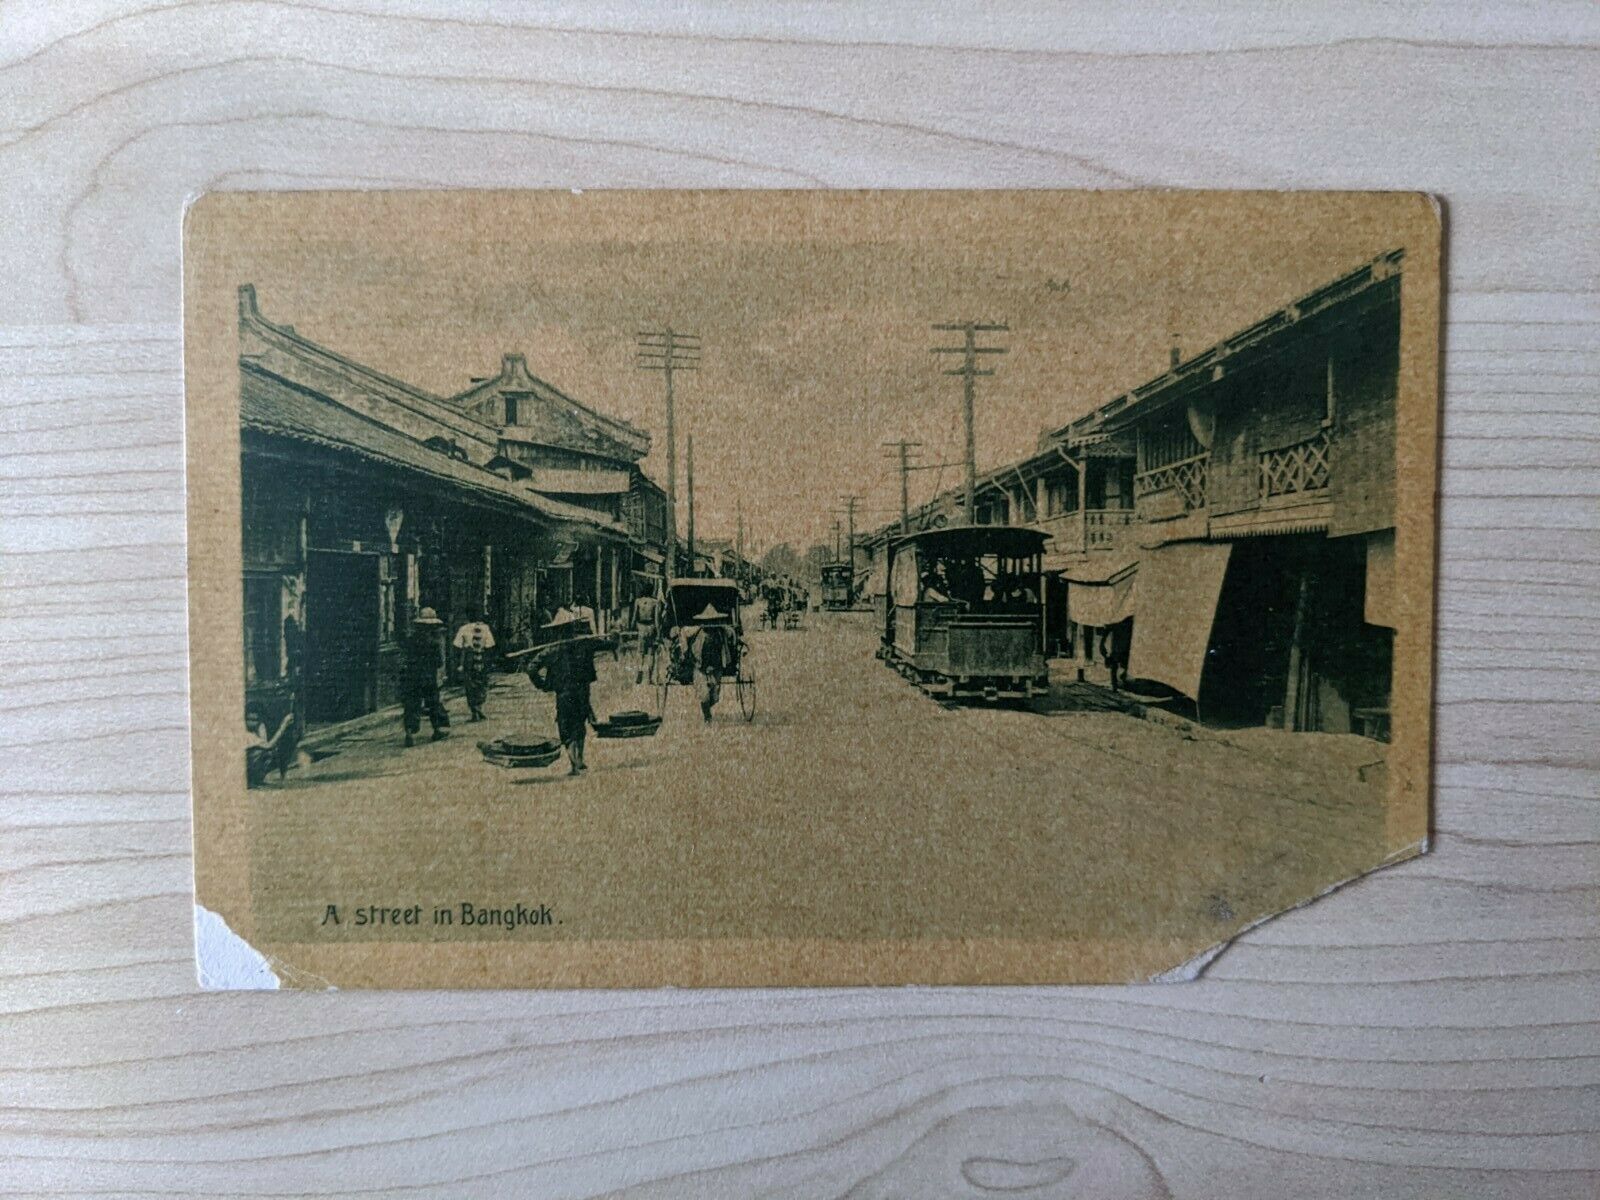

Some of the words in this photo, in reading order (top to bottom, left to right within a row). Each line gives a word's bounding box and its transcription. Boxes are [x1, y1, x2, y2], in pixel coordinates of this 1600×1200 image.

[322, 904, 341, 926] A
[356, 904, 423, 926] street
[433, 905, 453, 926] in
[460, 902, 564, 931] Bangkok.
